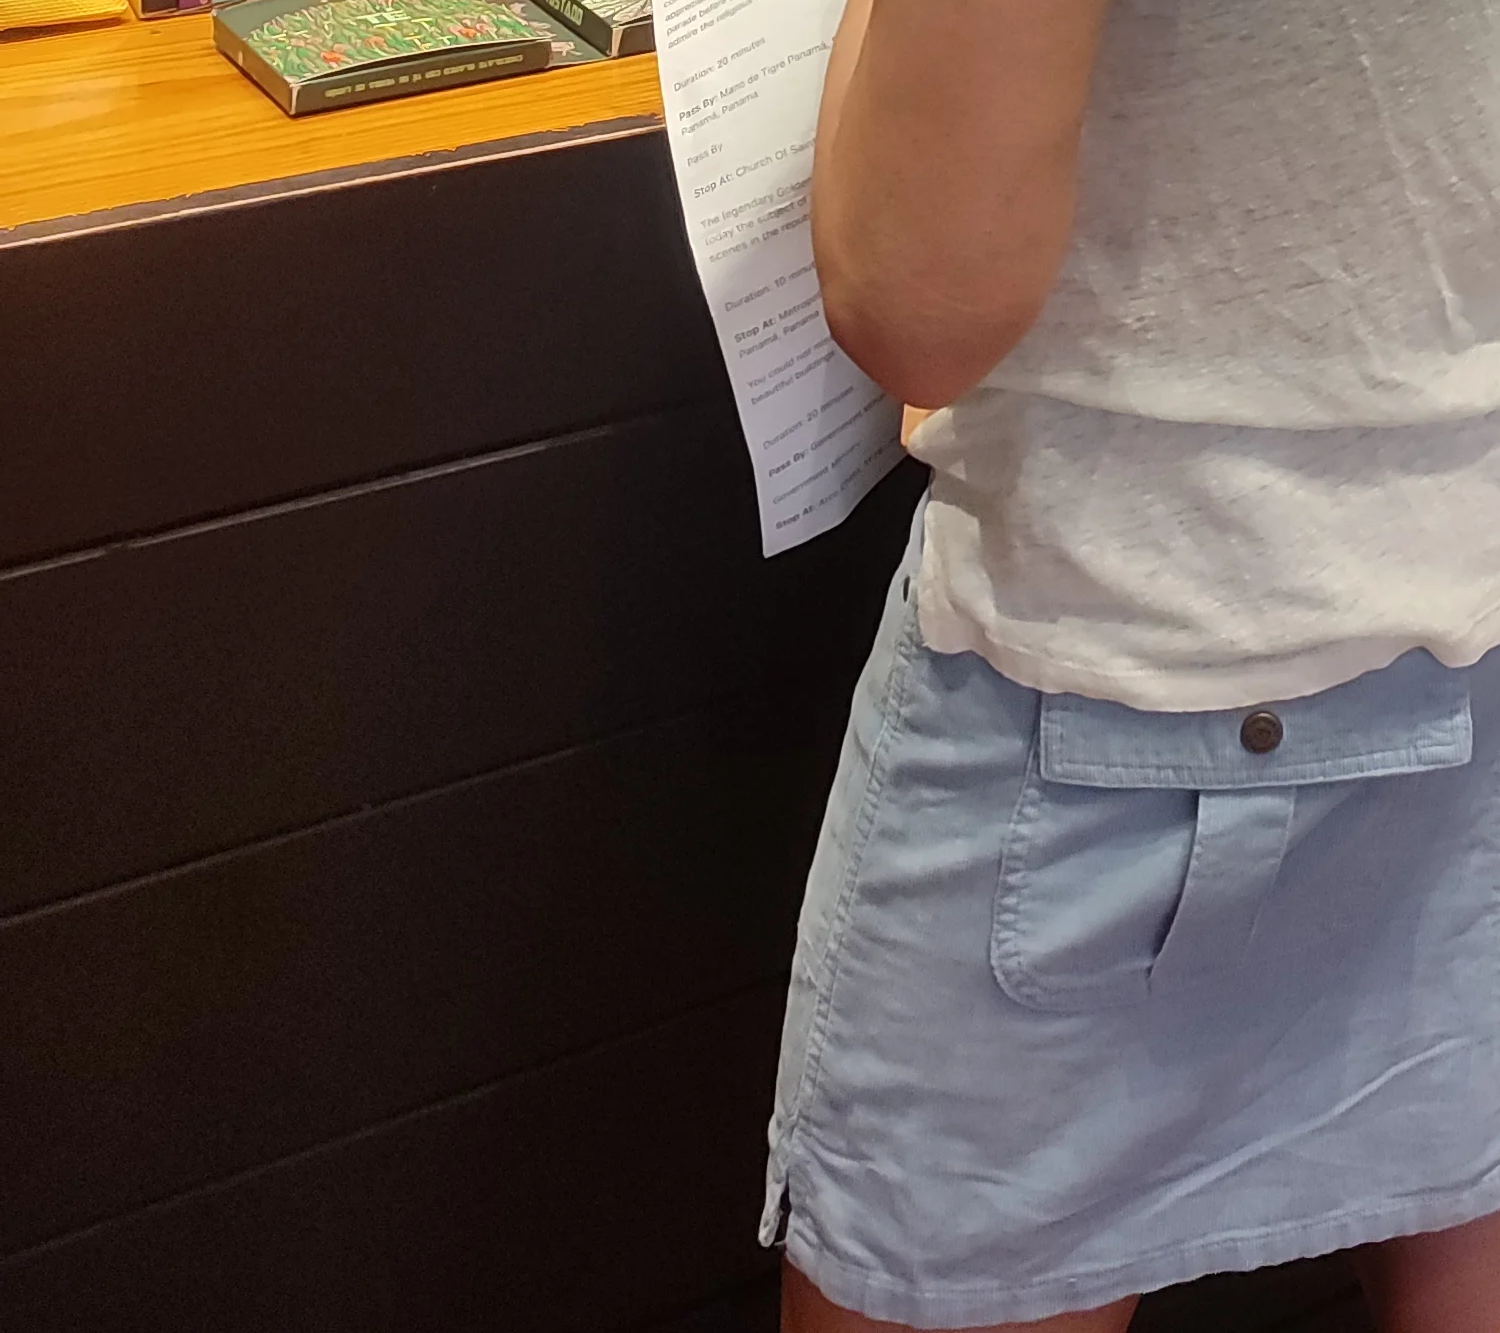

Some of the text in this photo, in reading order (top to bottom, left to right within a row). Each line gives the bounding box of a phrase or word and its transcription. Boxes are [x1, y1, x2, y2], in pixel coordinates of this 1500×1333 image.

[666, 13, 698, 38] parade
[668, 28, 699, 49] admire
[700, 19, 715, 32] the
[716, 56, 729, 69] 20
[730, 37, 766, 60] minutes
[678, 105, 701, 121] Pass
[747, 73, 759, 85] de
[760, 59, 786, 77] Tigre
[721, 91, 759, 115] Panama
[687, 143, 723, 167] Pass By
[693, 181, 717, 199] Stop
[735, 155, 773, 177] Church
[774, 147, 788, 161] Of
[700, 215, 720, 230] The
[721, 193, 775, 220] legendary
[705, 229, 734, 246] today
[735, 220, 755, 233] the
[757, 200, 796, 224] subject
[709, 227, 780, 263] scenes in the
[773, 275, 786, 288] 10
[734, 325, 760, 343] Stop
[747, 347, 811, 388] You could not
[751, 376, 794, 405] beautiful
[807, 408, 818, 422] 20
[768, 459, 791, 477] Pass
[775, 512, 800, 530] Stop
